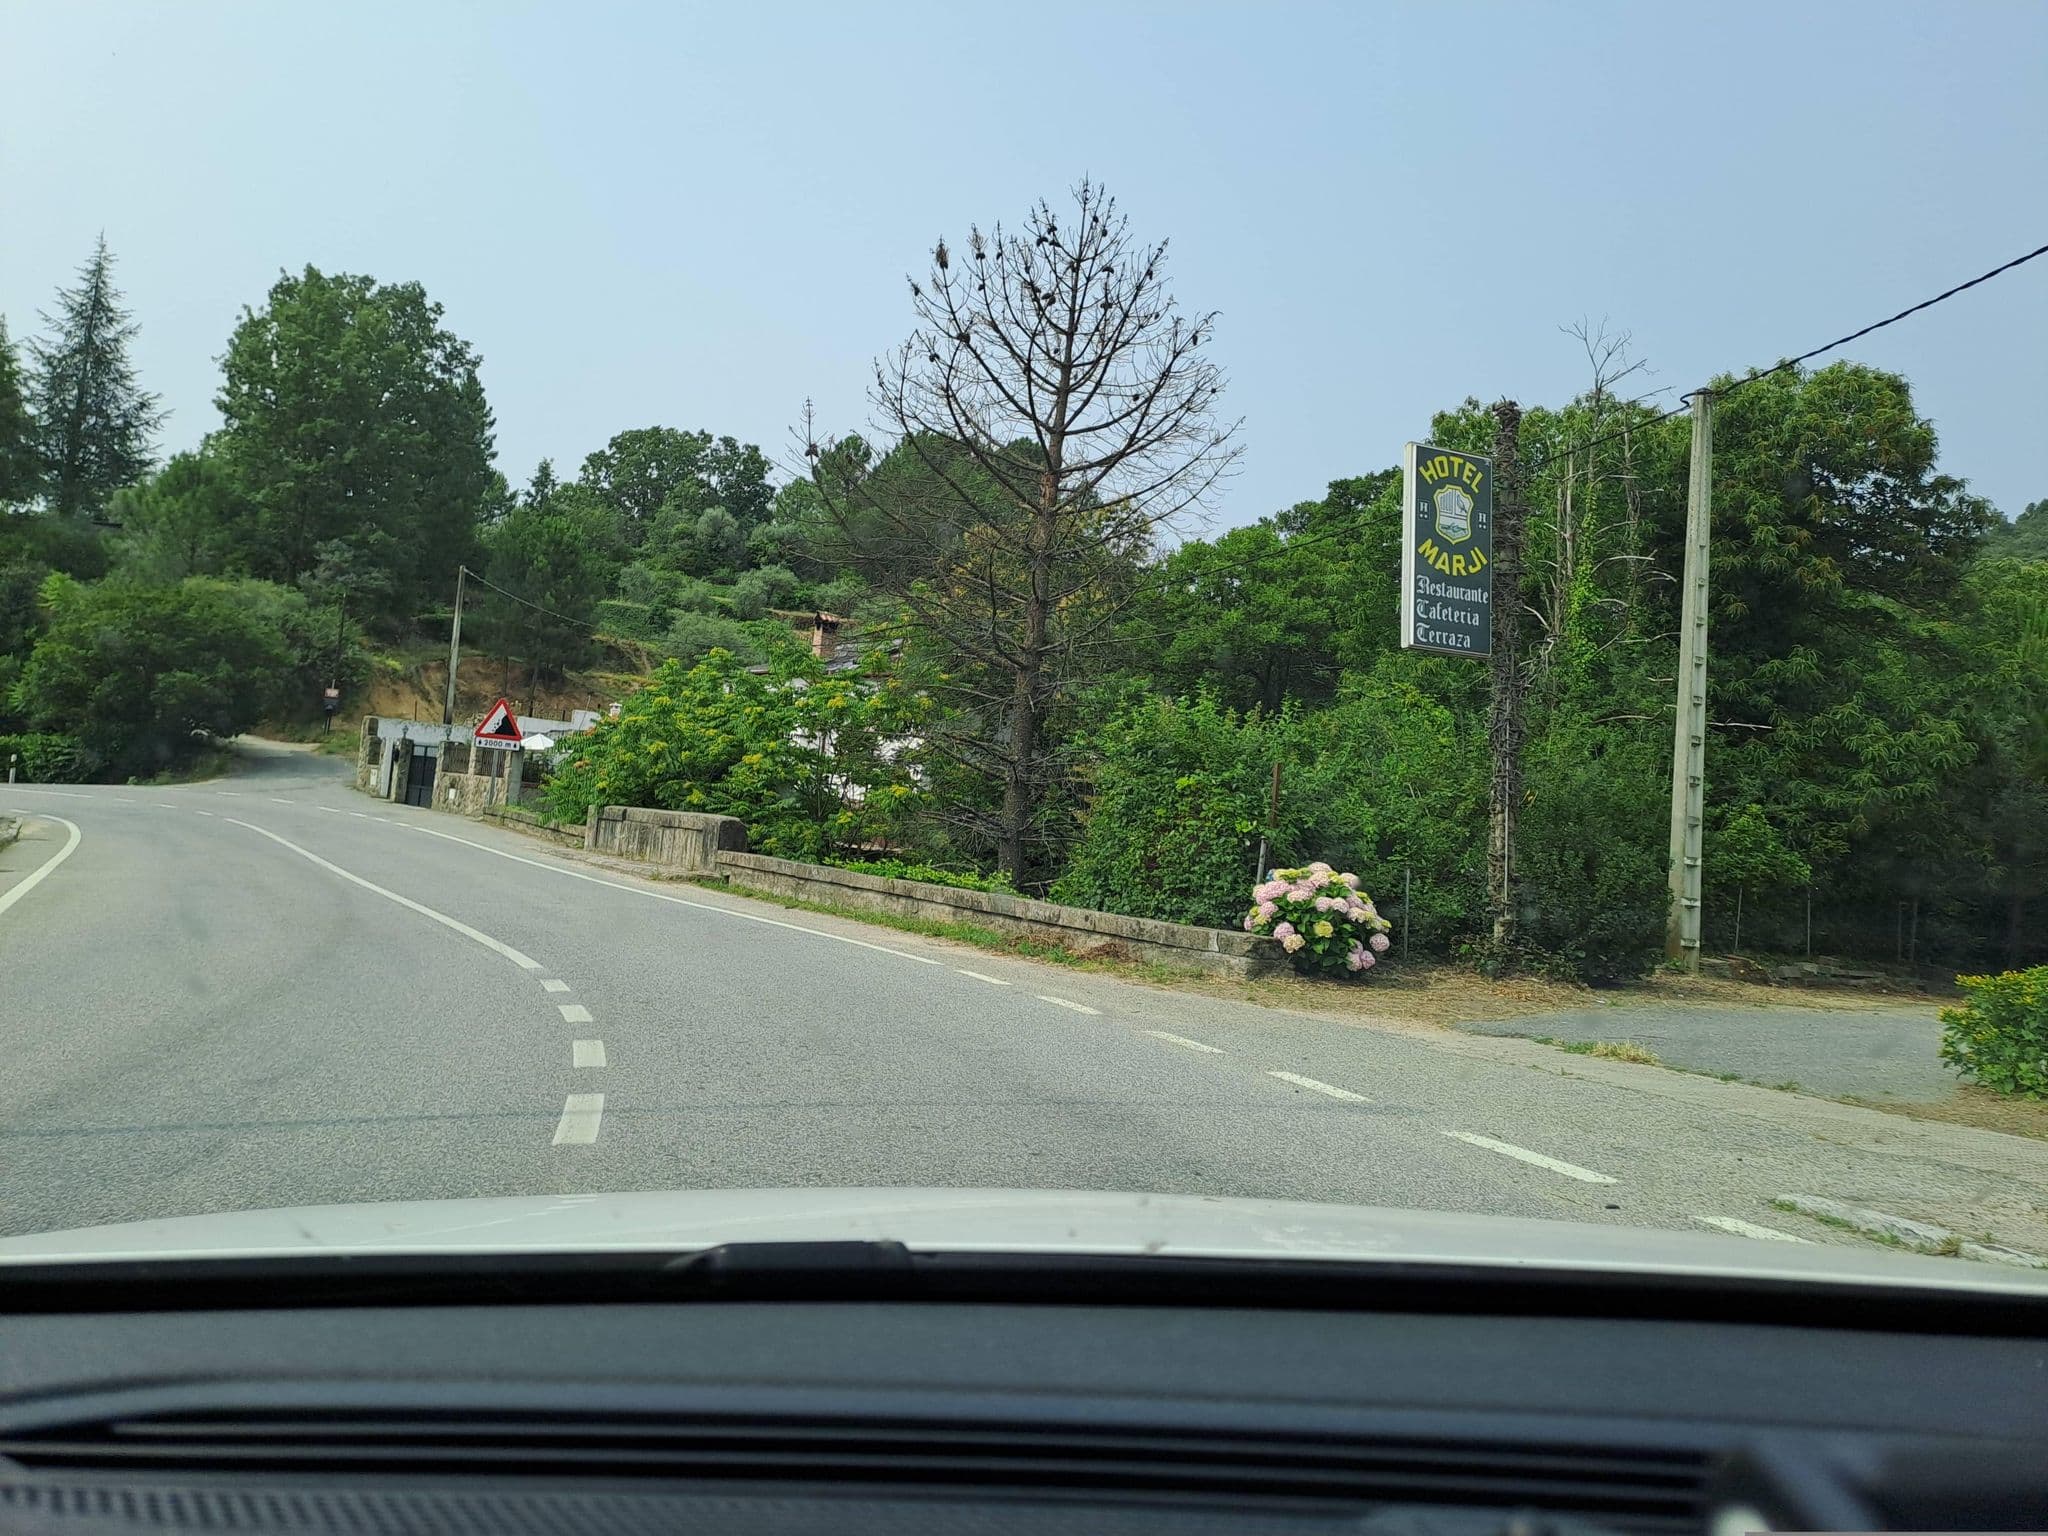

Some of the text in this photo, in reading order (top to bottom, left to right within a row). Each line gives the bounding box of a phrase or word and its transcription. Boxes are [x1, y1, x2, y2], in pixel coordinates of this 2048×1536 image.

[1419, 456, 1483, 493] HOTEL
[1418, 538, 1488, 576] MARJI
[1416, 574, 1489, 604] Restaurante
[1416, 622, 1471, 648] Terraza
[484, 739, 503, 747] 2000
